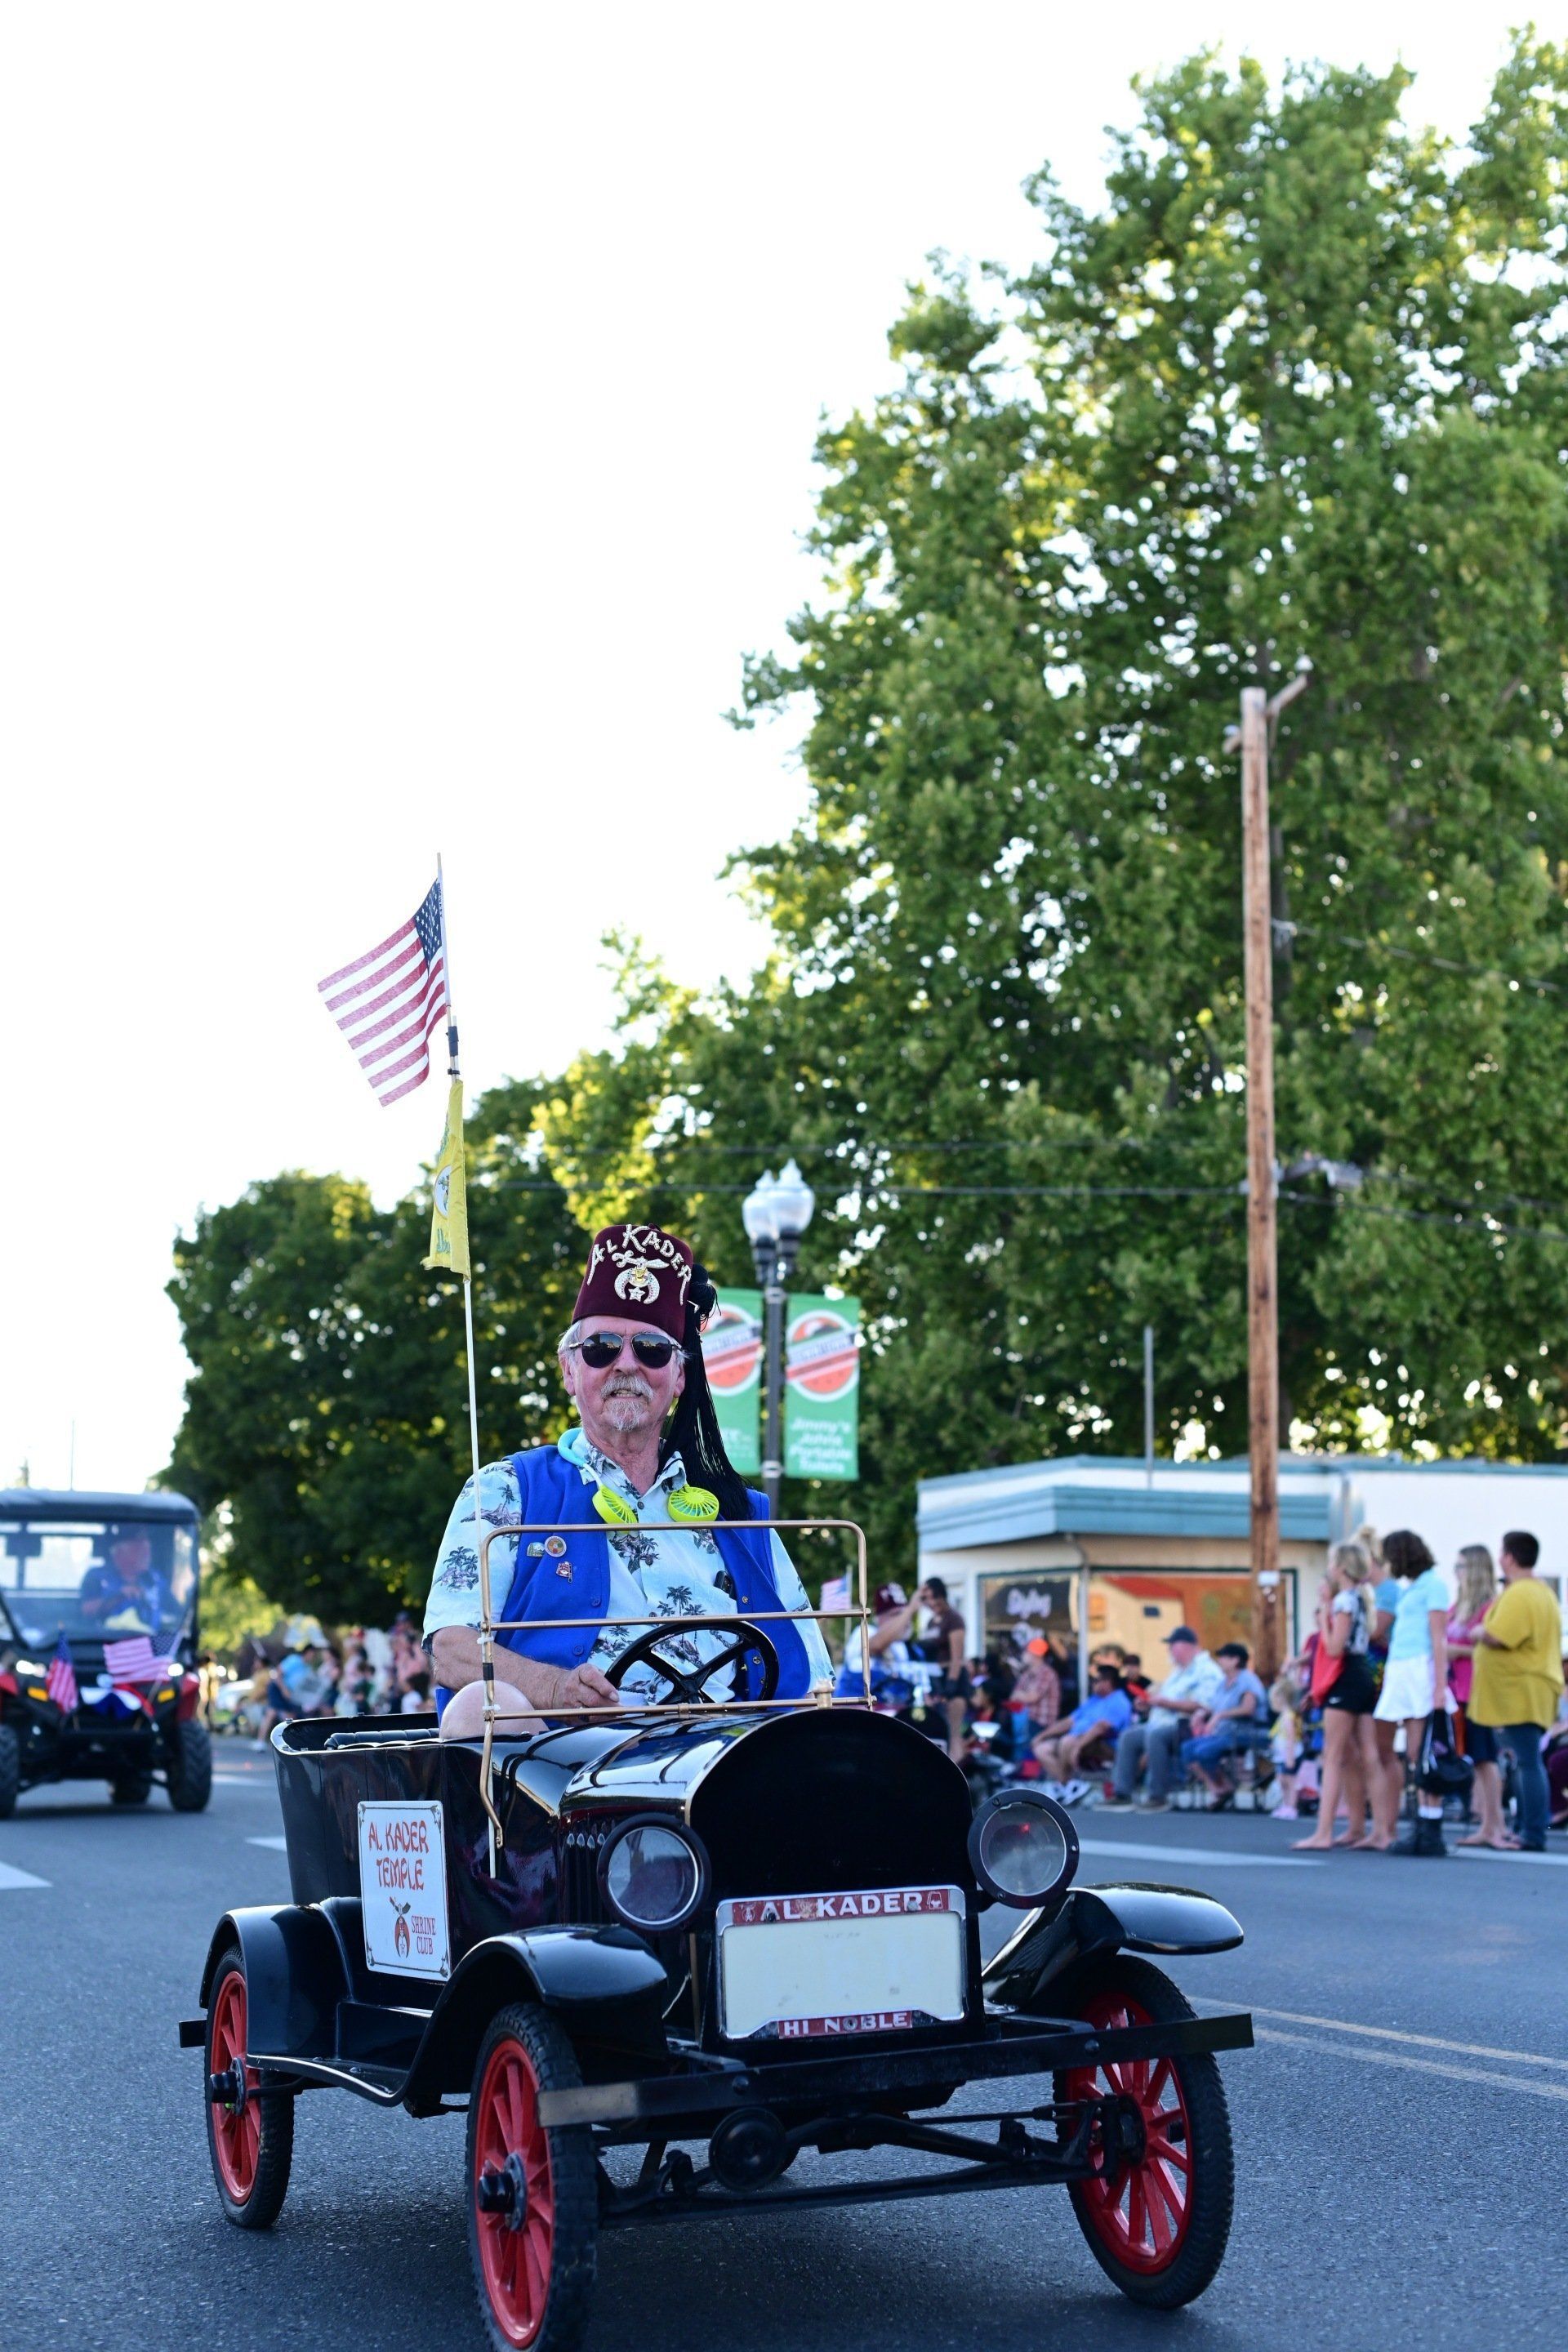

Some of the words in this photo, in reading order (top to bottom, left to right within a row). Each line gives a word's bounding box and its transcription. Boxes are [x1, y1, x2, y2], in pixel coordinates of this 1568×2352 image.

[586, 1239, 618, 1285] AL
[621, 1224, 693, 1306] KADER
[368, 1821, 383, 1851] AL
[385, 1820, 430, 1854] KADER
[376, 1857, 425, 1891] TEMPLE
[760, 1901, 801, 1922] AL
[816, 1892, 923, 1918] KADER
[411, 1915, 436, 1936] SHRINE
[416, 1937, 434, 1955] CLUB
[784, 2019, 809, 2036] HI
[824, 2012, 908, 2033] NBLE
